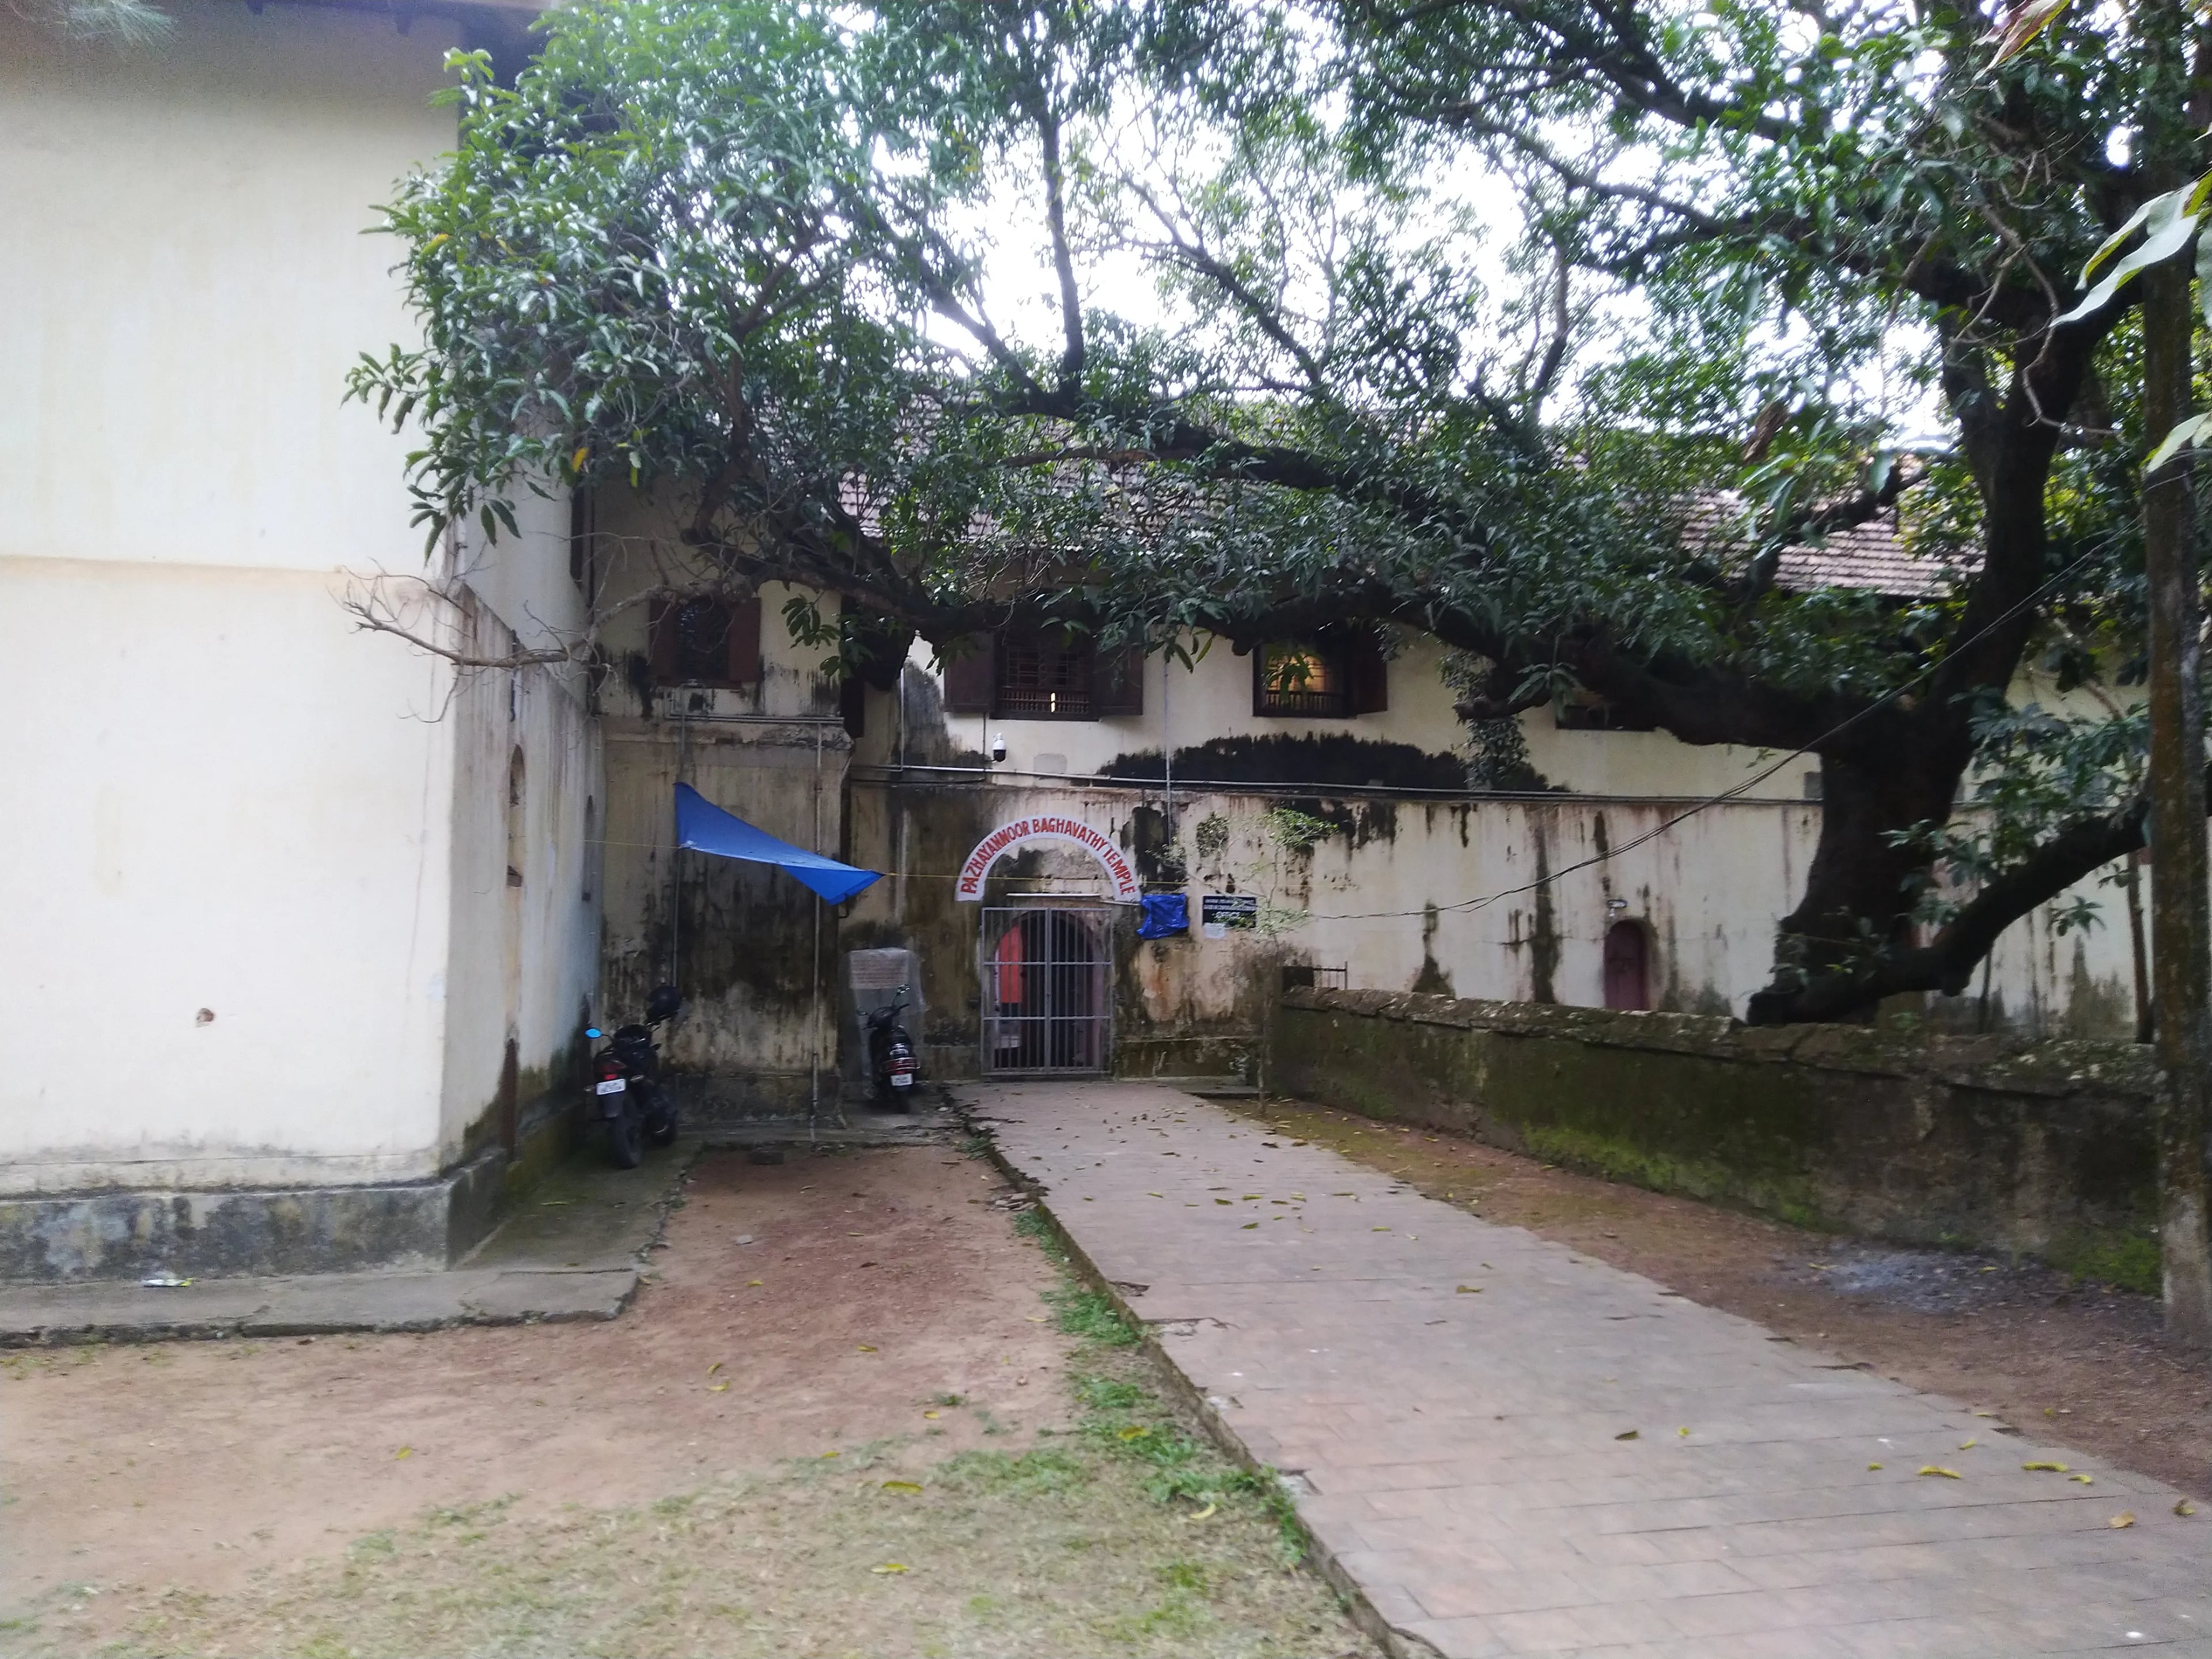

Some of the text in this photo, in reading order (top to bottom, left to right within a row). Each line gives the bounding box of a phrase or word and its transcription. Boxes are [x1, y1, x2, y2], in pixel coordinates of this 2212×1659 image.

[960, 817, 1135, 895] PAZHAYANNOOR BAGHAVATHY TEMPLE
